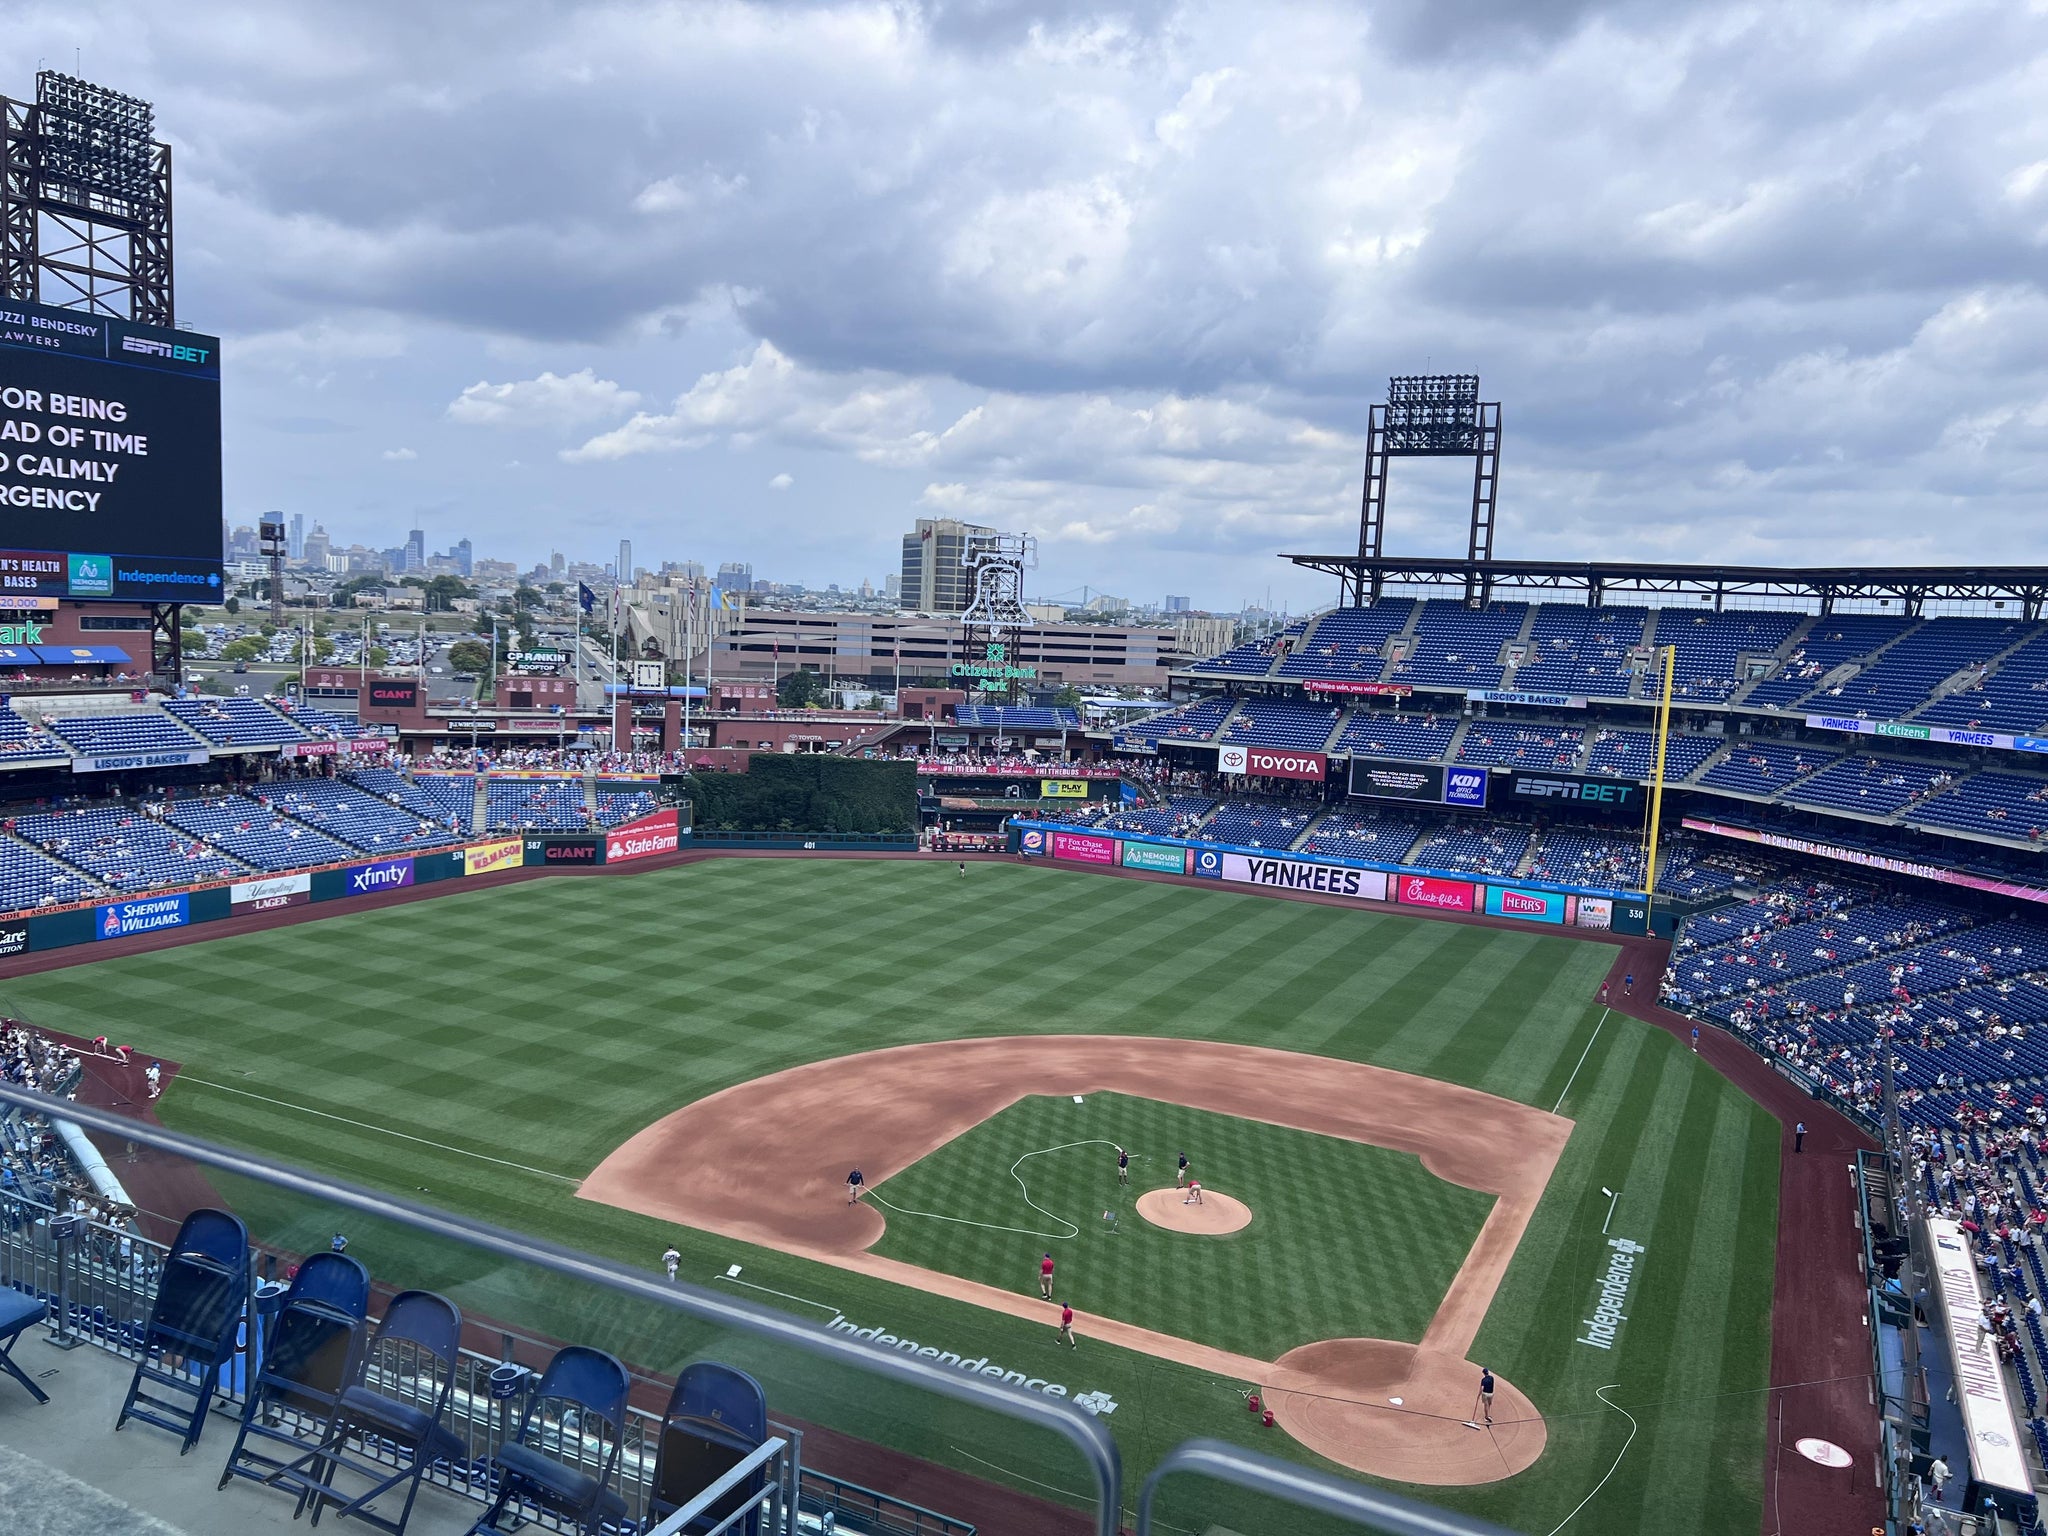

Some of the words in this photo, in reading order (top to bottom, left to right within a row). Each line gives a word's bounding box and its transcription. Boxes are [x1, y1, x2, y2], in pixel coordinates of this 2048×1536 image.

[31, 316, 97, 337] BENDESKY
[122, 336, 172, 358] ESPN
[173, 345, 209, 363] BET
[0, 387, 42, 412] OR
[50, 393, 127, 422] BEING
[1, 420, 41, 442] AD
[48, 426, 84, 448] OF
[90, 430, 148, 456] TIME
[17, 453, 119, 482] CALMLY
[0, 559, 18, 571] N'S
[22, 560, 60, 573] HEALTH
[4, 576, 37, 588] BASES
[118, 570, 205, 585] Independence
[0, 620, 43, 645] ark
[525, 653, 566, 662] RANKIN
[952, 663, 1004, 677] Citizens
[1005, 665, 1037, 679] Bank
[980, 679, 1008, 691] Park
[1312, 682, 1335, 690] Phillies
[373, 690, 413, 699] GIANT
[1484, 692, 1525, 701] LISCIO'S
[1529, 695, 1569, 705] BAKERY
[1821, 717, 1859, 730] YANKEES
[1887, 726, 1926, 738] Citizens
[1948, 731, 1994, 745] YANKEES
[299, 744, 335, 755] TOYOTA
[352, 741, 387, 751] TOYOTA
[94, 757, 143, 769] LISCIO'S
[146, 753, 190, 765] BAKERY
[1251, 755, 1319, 774] TOYOTA
[1450, 774, 1481, 788] KDI
[1448, 791, 1480, 800] TECHNOLOGY
[1515, 778, 1580, 799] ESPN
[1581, 783, 1633, 803] BET
[527, 841, 541, 850] 387
[625, 840, 649, 855] State
[652, 835, 677, 850] Farm
[804, 841, 815, 849] 401
[1067, 838, 1080, 846] Fox
[1081, 839, 1103, 848] Chase
[452, 851, 463, 861] 374
[546, 847, 595, 859] GIANT
[1090, 847, 1111, 855] Center
[1142, 851, 1180, 863] NEMOURS
[1772, 835, 1815, 854] CHILDREN'S
[1816, 844, 1846, 859] HEALTH
[1848, 850, 1866, 865] KIDS
[1868, 855, 1886, 869] RUN
[1887, 859, 1905, 872] THE
[1907, 863, 1934, 879] BASES
[353, 864, 407, 891] xfinity
[1248, 858, 1360, 895] YANKEES
[145, 886, 190, 898] ASPLUNDH
[248, 878, 297, 898] Yuengling
[90, 894, 137, 907] ASPLUNDH
[255, 897, 288, 910] LAGER
[1506, 896, 1541, 911] HERR'S
[31, 902, 80, 916] ASPLUNDH
[122, 899, 179, 918] SHERWIN
[1583, 904, 1606, 913] WM
[1628, 909, 1643, 919] 330
[1576, 1253, 1635, 1350] Independence
